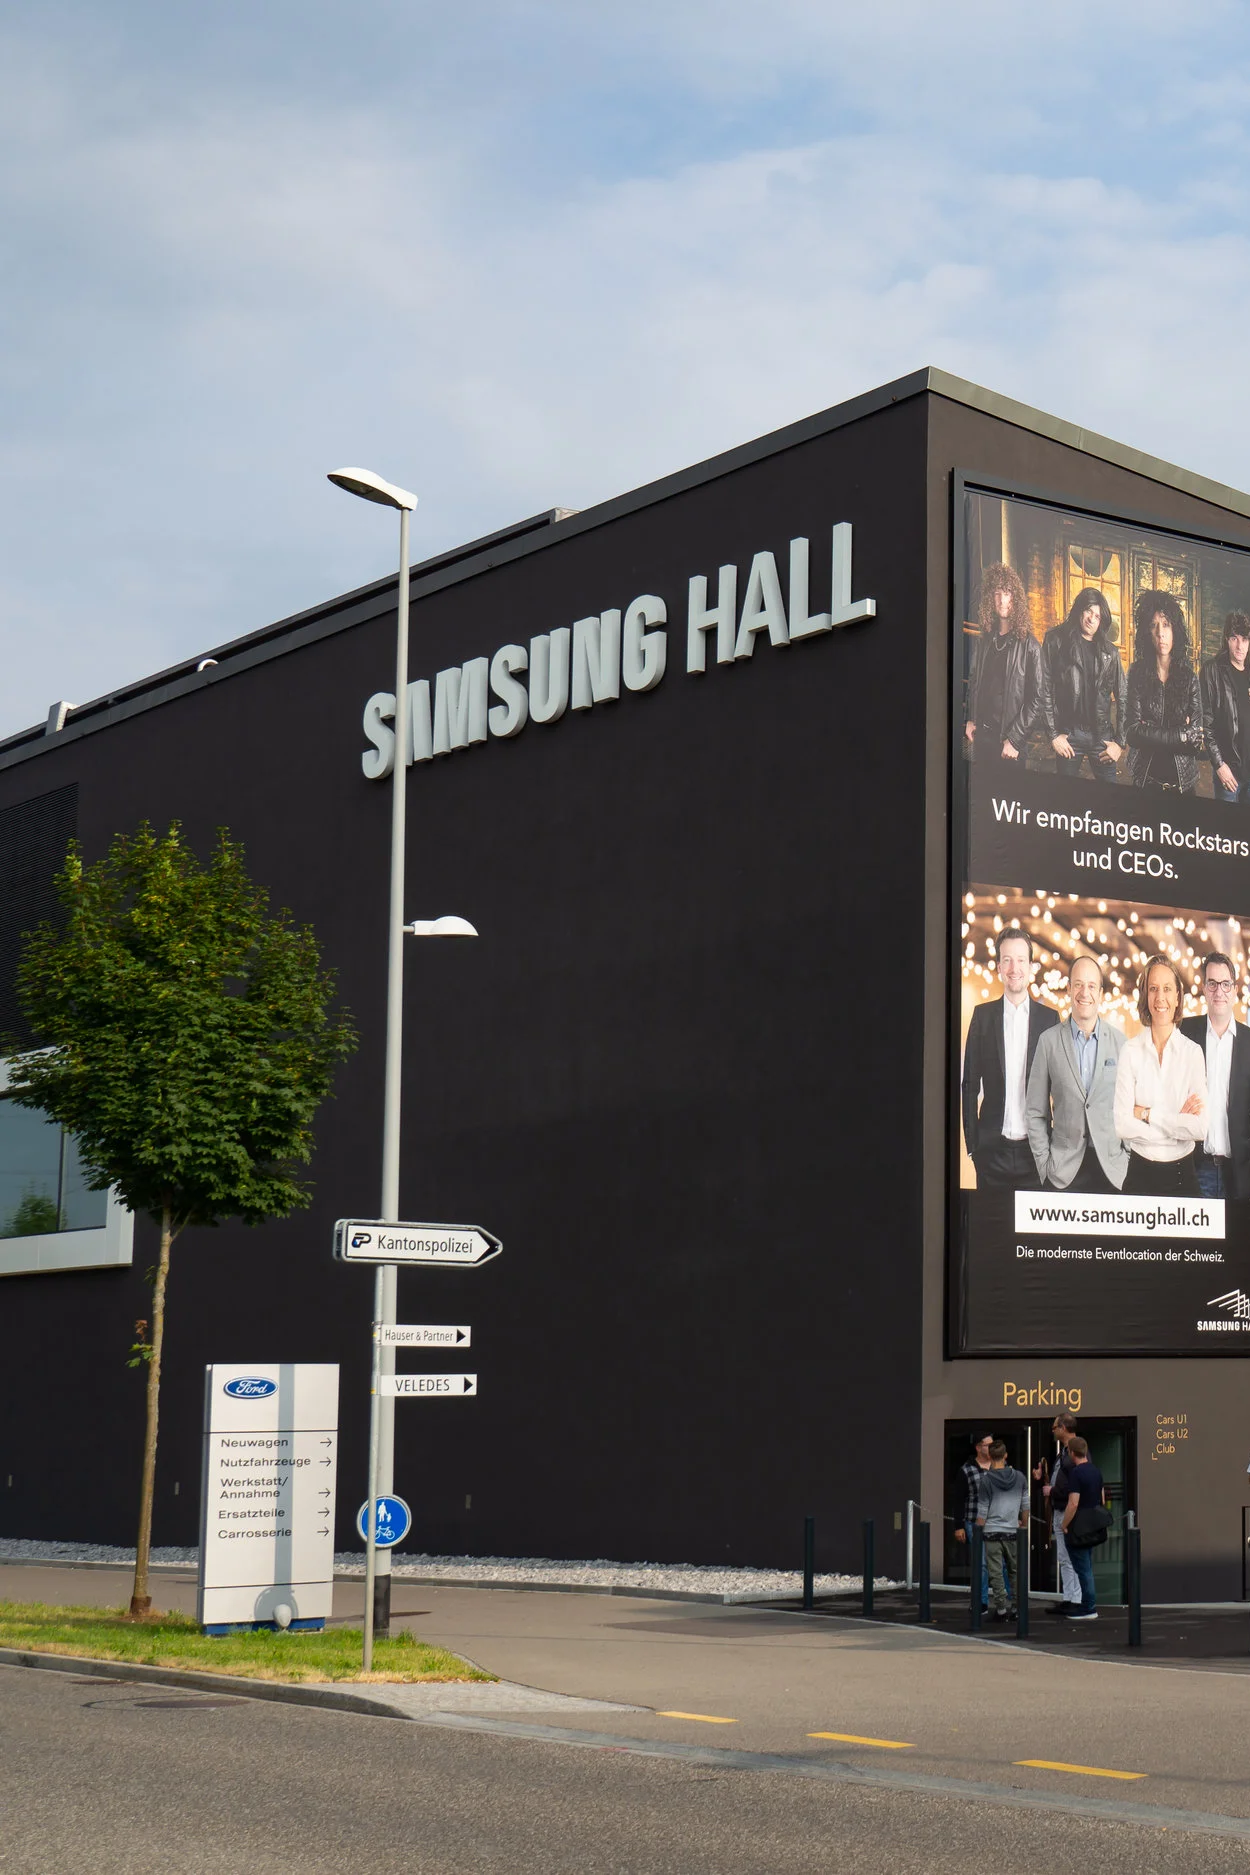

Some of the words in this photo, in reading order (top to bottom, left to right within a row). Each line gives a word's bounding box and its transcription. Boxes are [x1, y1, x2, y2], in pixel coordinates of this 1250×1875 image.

[362, 594, 667, 780] SAMSUNG
[687, 521, 877, 674] HALL
[992, 798, 1031, 824] Wir
[1036, 810, 1153, 845] empfangen
[1160, 822, 1250, 857] Rockstars
[1073, 848, 1112, 870] und
[1118, 850, 1179, 880] CEOs.
[1029, 1204, 1210, 1230] www.samsunghall.ch
[377, 1234, 474, 1256] Kantonspolizei
[1016, 1246, 1034, 1259] Die
[1037, 1247, 1093, 1260] modernste
[1095, 1248, 1163, 1262] Eventlocation
[1165, 1250, 1182, 1262] der
[1184, 1250, 1225, 1263] Schweiz.
[1197, 1321, 1240, 1331] SAMSUNG
[385, 1329, 413, 1341] Hauser
[416, 1331, 421, 1341] &
[423, 1330, 453, 1342] Partner
[236, 1380, 267, 1396] Ford
[395, 1378, 450, 1392] VELEDES
[1003, 1380, 1082, 1412] Parking
[1156, 1414, 1174, 1425] Cars
[1177, 1414, 1187, 1425] U1
[1156, 1429, 1174, 1440] Cars
[1177, 1428, 1188, 1440] U2
[221, 1438, 289, 1449] Neuwagen
[1156, 1443, 1176, 1455] Club
[220, 1456, 311, 1469] Nutzfahrzeuge
[220, 1476, 288, 1488] Werkstatt/
[220, 1488, 280, 1499] Annahme
[218, 1507, 285, 1519] Ersatzteile
[218, 1527, 292, 1539] Carrosserie
